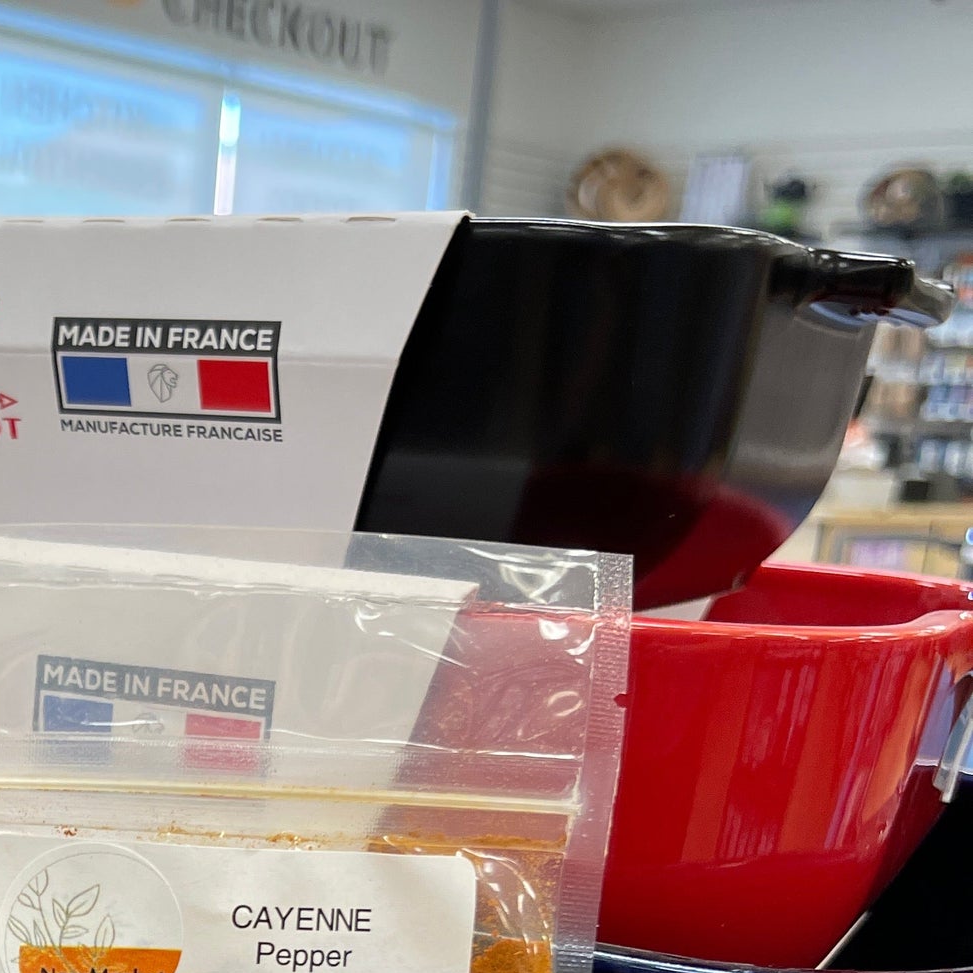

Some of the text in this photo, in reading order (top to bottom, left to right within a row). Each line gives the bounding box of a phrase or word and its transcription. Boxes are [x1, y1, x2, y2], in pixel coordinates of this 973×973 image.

[57, 324, 274, 351] MADE IN FRANCE
[60, 419, 284, 443] MANUFACTURE FRANCAISE
[43, 663, 268, 711] MADE IN FRANCE
[231, 904, 373, 933] CAYENNE
[256, 941, 353, 973] Pepper
